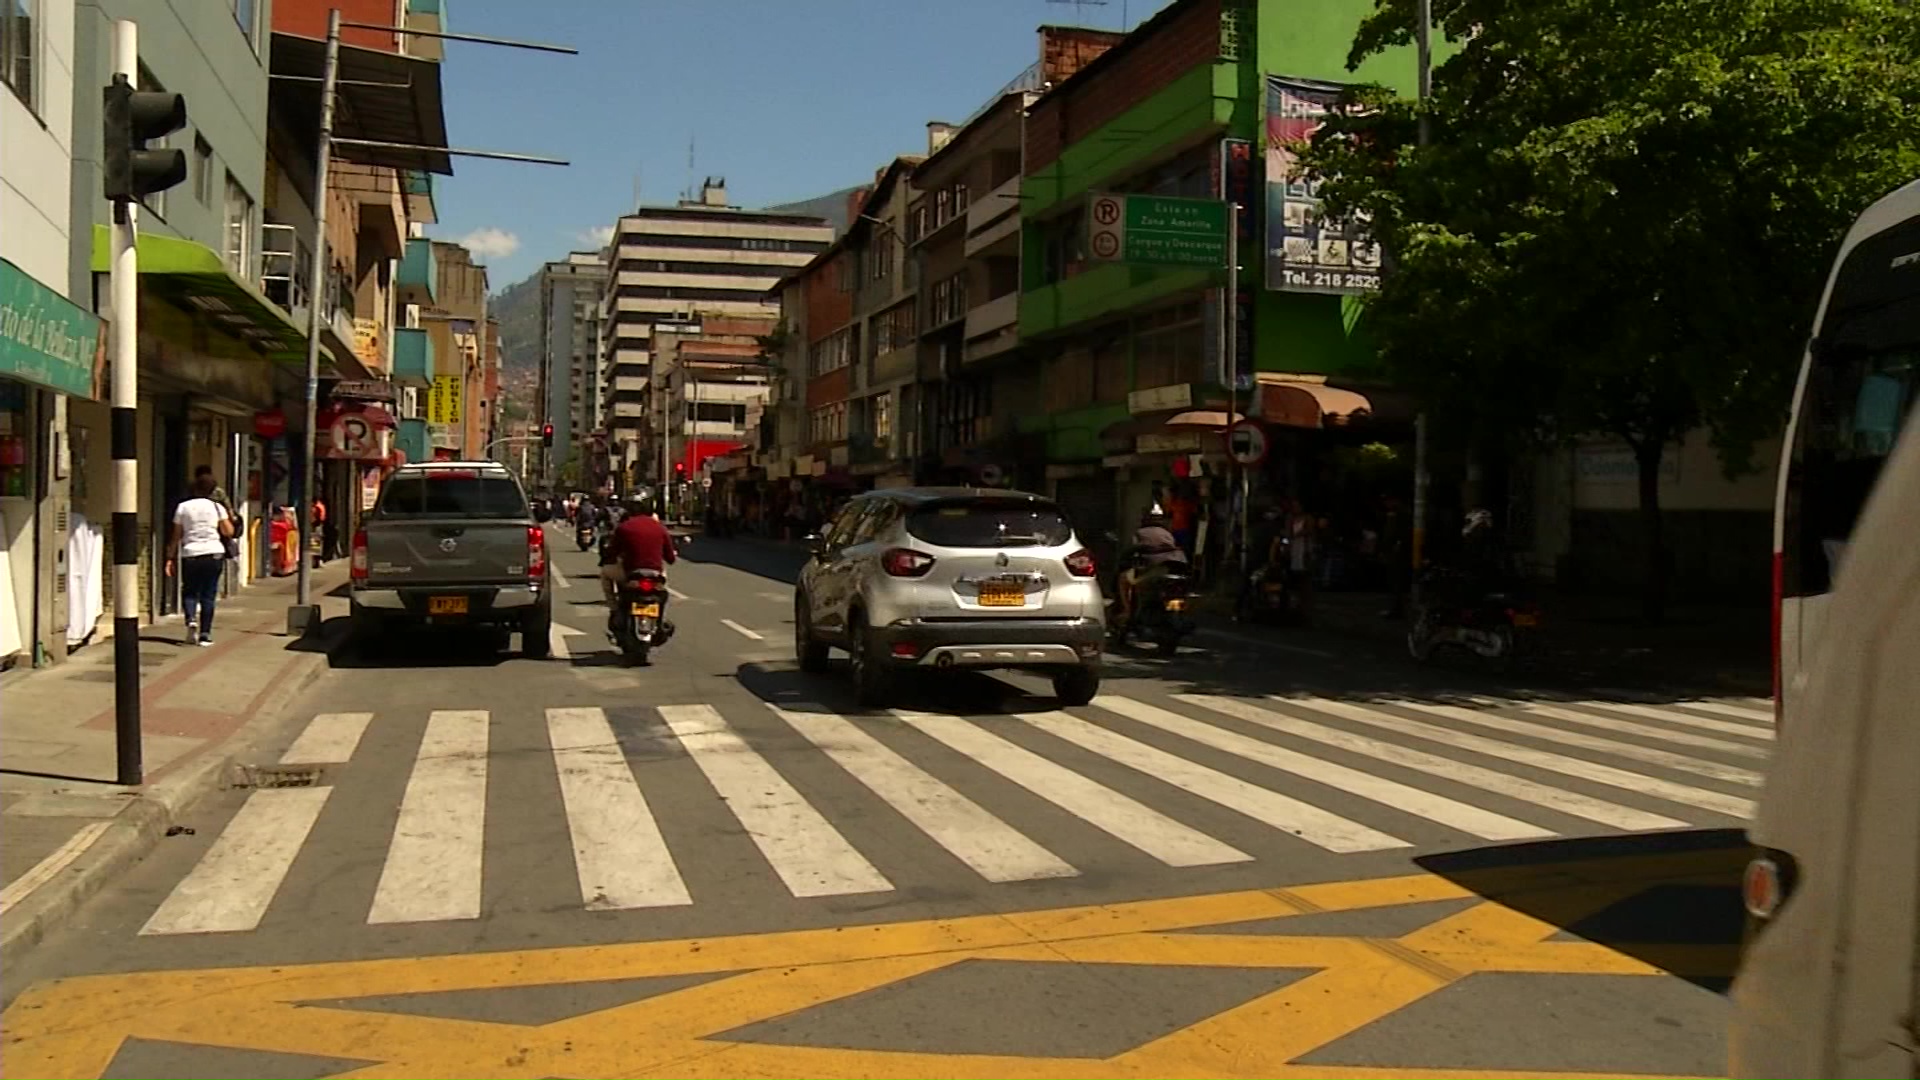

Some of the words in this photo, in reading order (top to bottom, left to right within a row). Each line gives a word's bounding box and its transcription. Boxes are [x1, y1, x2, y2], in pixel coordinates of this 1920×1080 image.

[1141, 215, 1165, 226] Zona
[1171, 217, 1212, 229] Amarilla
[1128, 236, 1163, 248] Cargue
[1172, 238, 1222, 251] Descargue
[1282, 270, 1310, 285] Tel.
[1314, 272, 1342, 286] 218
